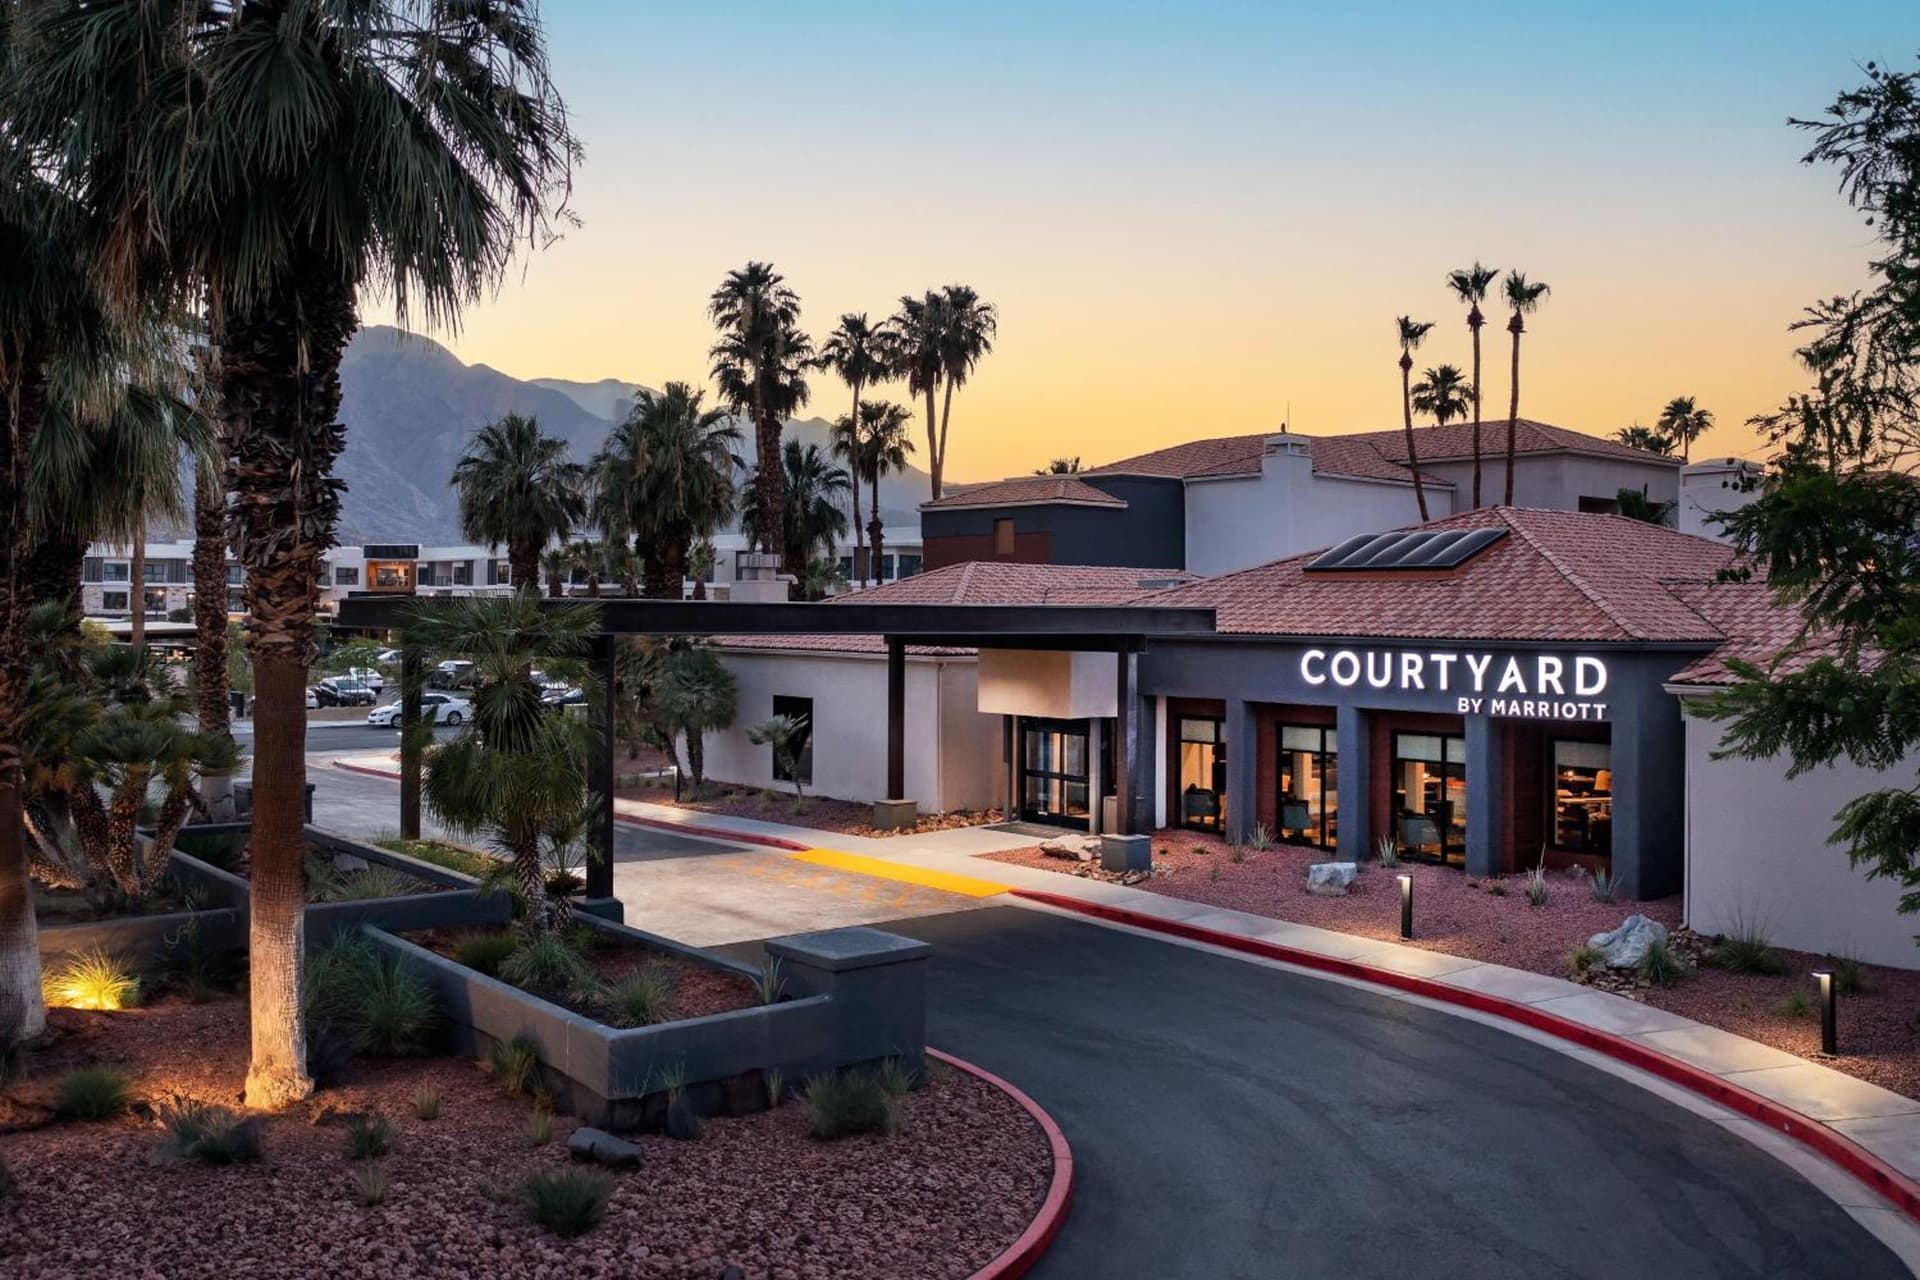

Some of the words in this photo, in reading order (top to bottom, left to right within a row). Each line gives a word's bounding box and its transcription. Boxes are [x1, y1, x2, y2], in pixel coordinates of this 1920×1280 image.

[1300, 649, 1607, 695] COURTYARD
[1457, 697, 1483, 713] BY
[1490, 699, 1607, 720] MARRIOTT
